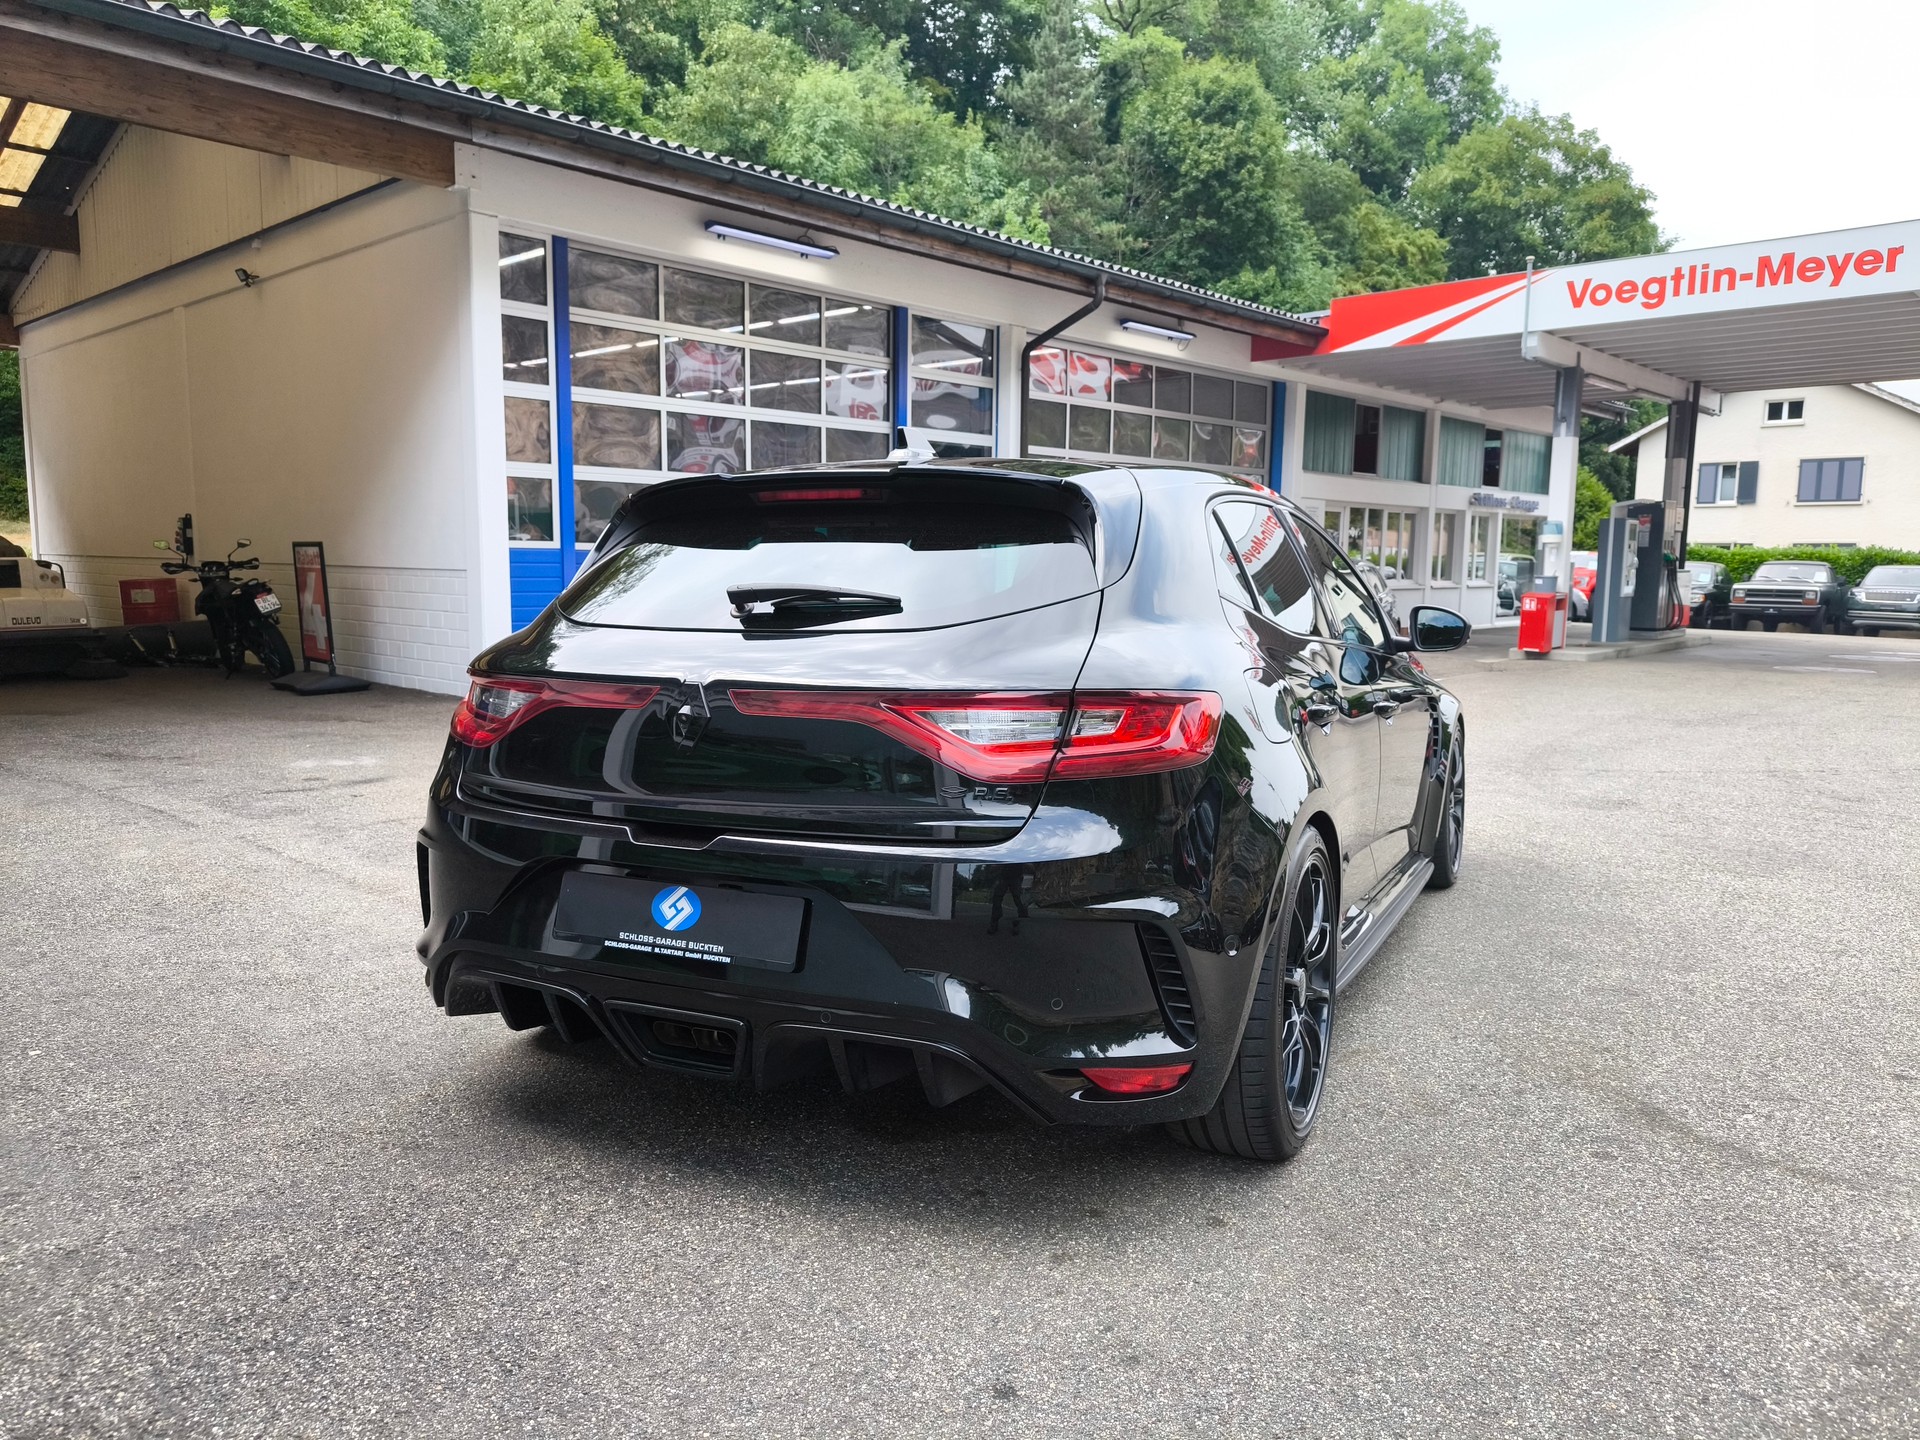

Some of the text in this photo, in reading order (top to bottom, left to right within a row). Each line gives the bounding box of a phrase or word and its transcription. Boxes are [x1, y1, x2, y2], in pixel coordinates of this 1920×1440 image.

[1566, 245, 1904, 309] Voegtlin-Meyer
[12, 616, 42, 625] DULEVO
[604, 940, 652, 953] SCHLOSS-GARAGE
[685, 951, 702, 959] GmbH
[703, 954, 731, 963] BUCKTEN
[619, 932, 724, 953] SCHLOSS-GARAGE BUCKTEN
